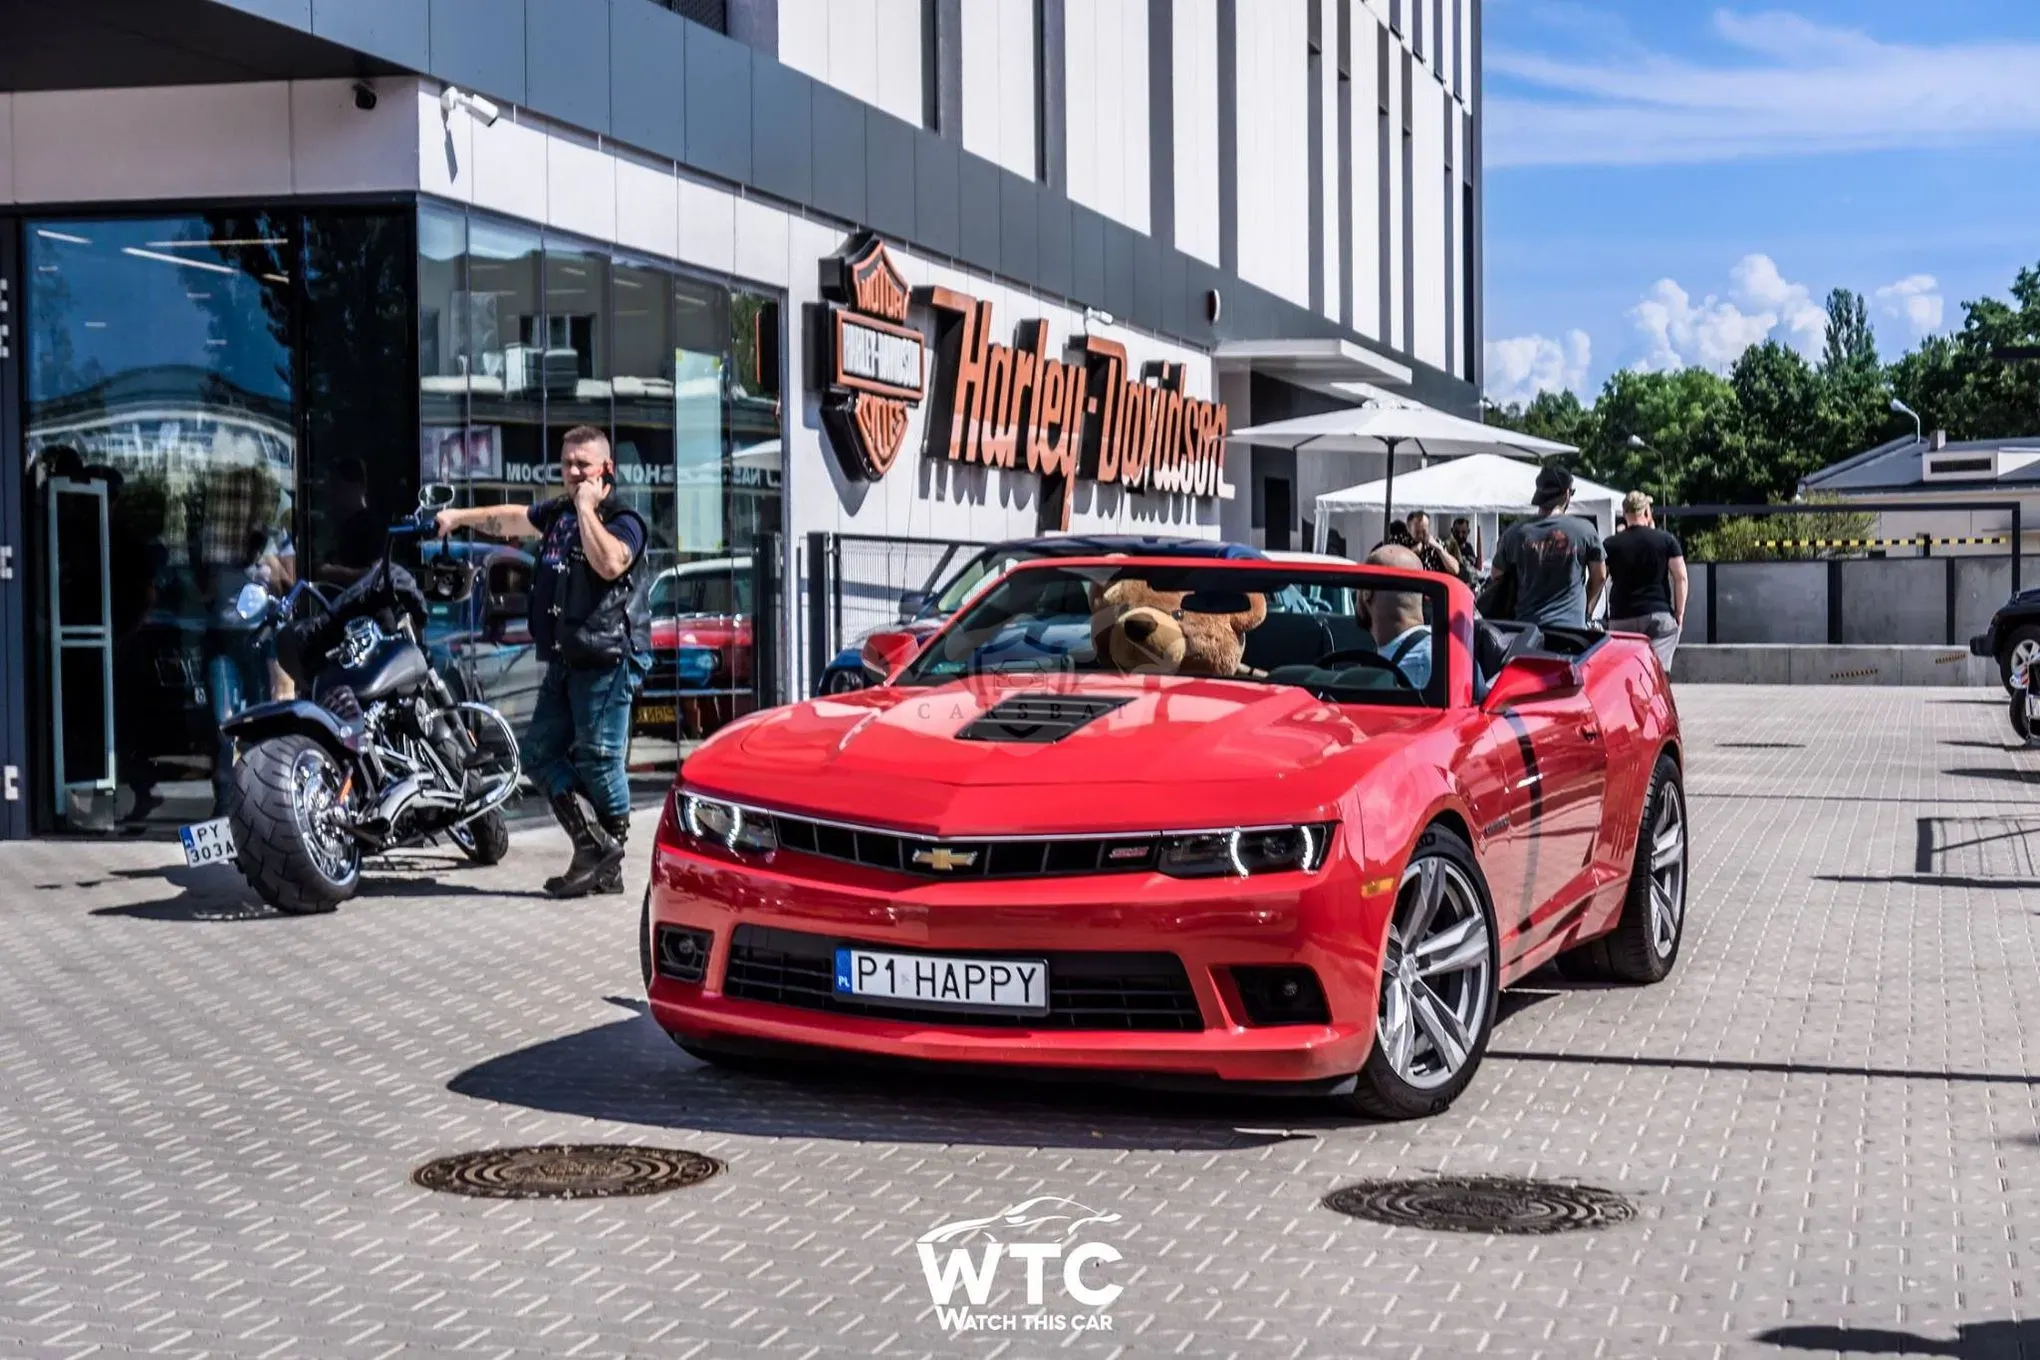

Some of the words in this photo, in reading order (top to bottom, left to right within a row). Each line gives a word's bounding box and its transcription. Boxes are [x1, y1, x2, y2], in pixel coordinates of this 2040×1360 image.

[197, 824, 218, 841] PY
[190, 840, 235, 863] 303A
[857, 955, 896, 994] P1
[915, 960, 1037, 1003] HAPPY
